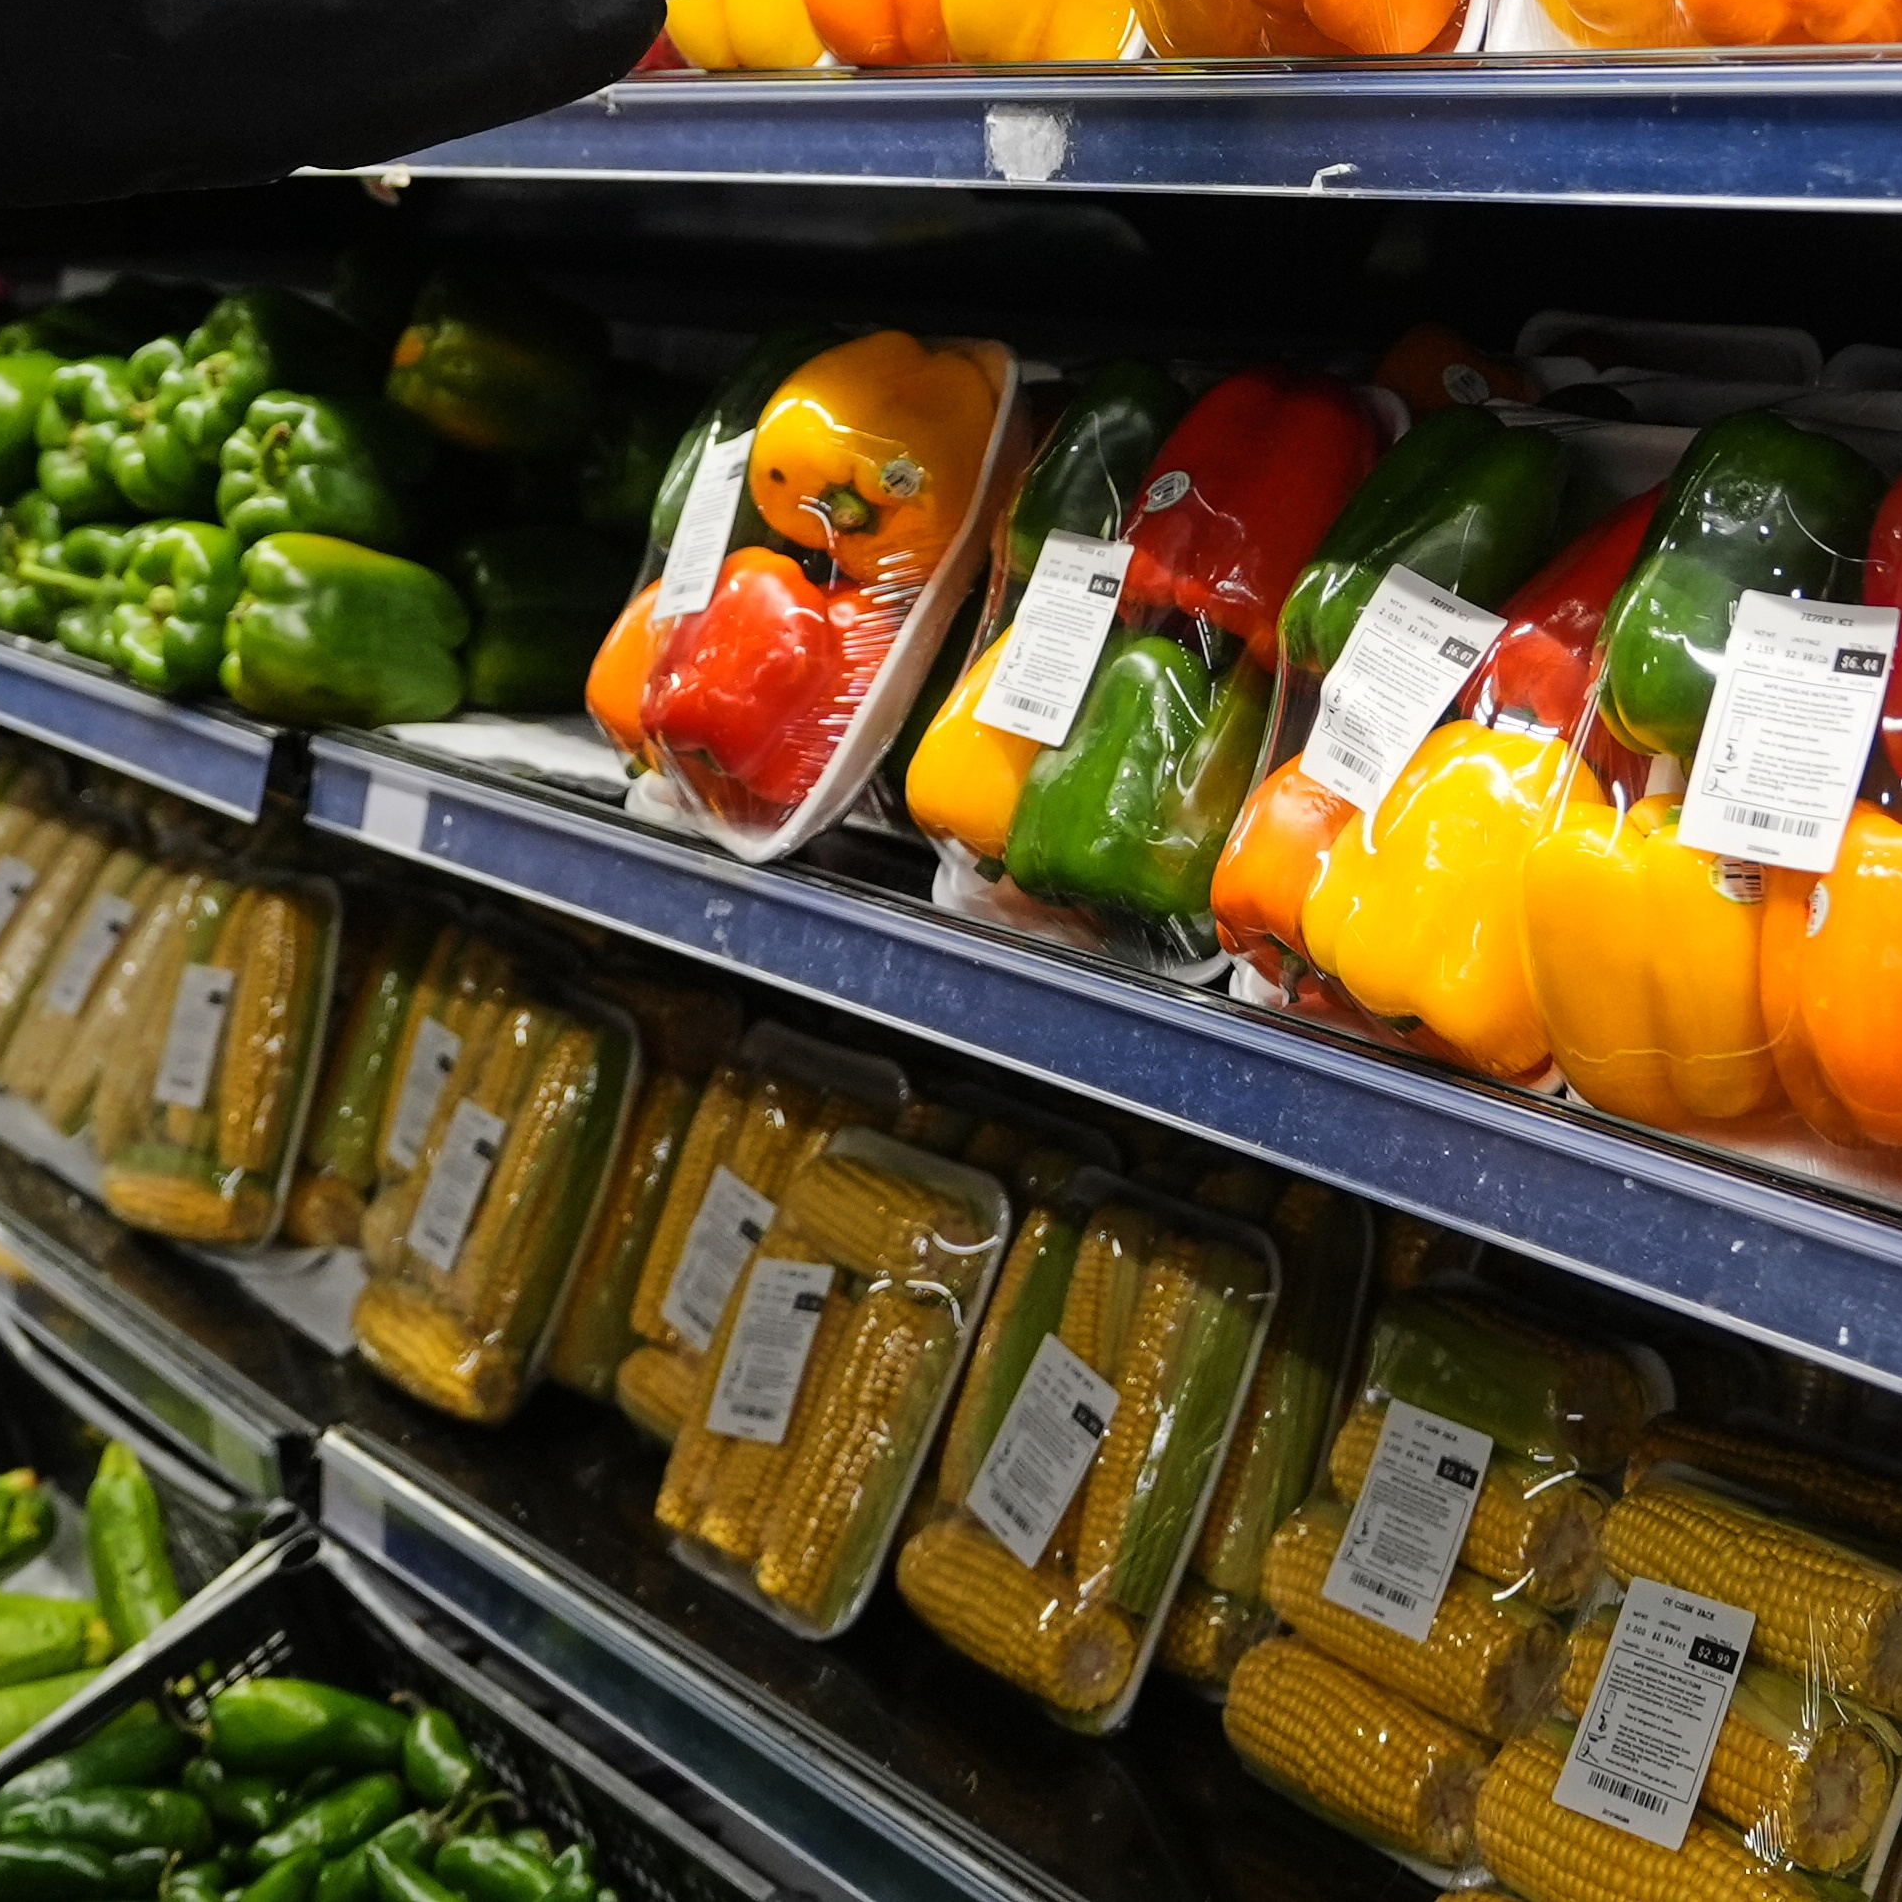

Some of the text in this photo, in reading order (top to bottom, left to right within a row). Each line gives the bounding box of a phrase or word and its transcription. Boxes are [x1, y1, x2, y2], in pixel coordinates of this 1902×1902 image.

[1444, 642, 1474, 665] $6.07
[1839, 652, 1880, 674] $6.44
[1695, 1646, 1731, 1667] $2.99
